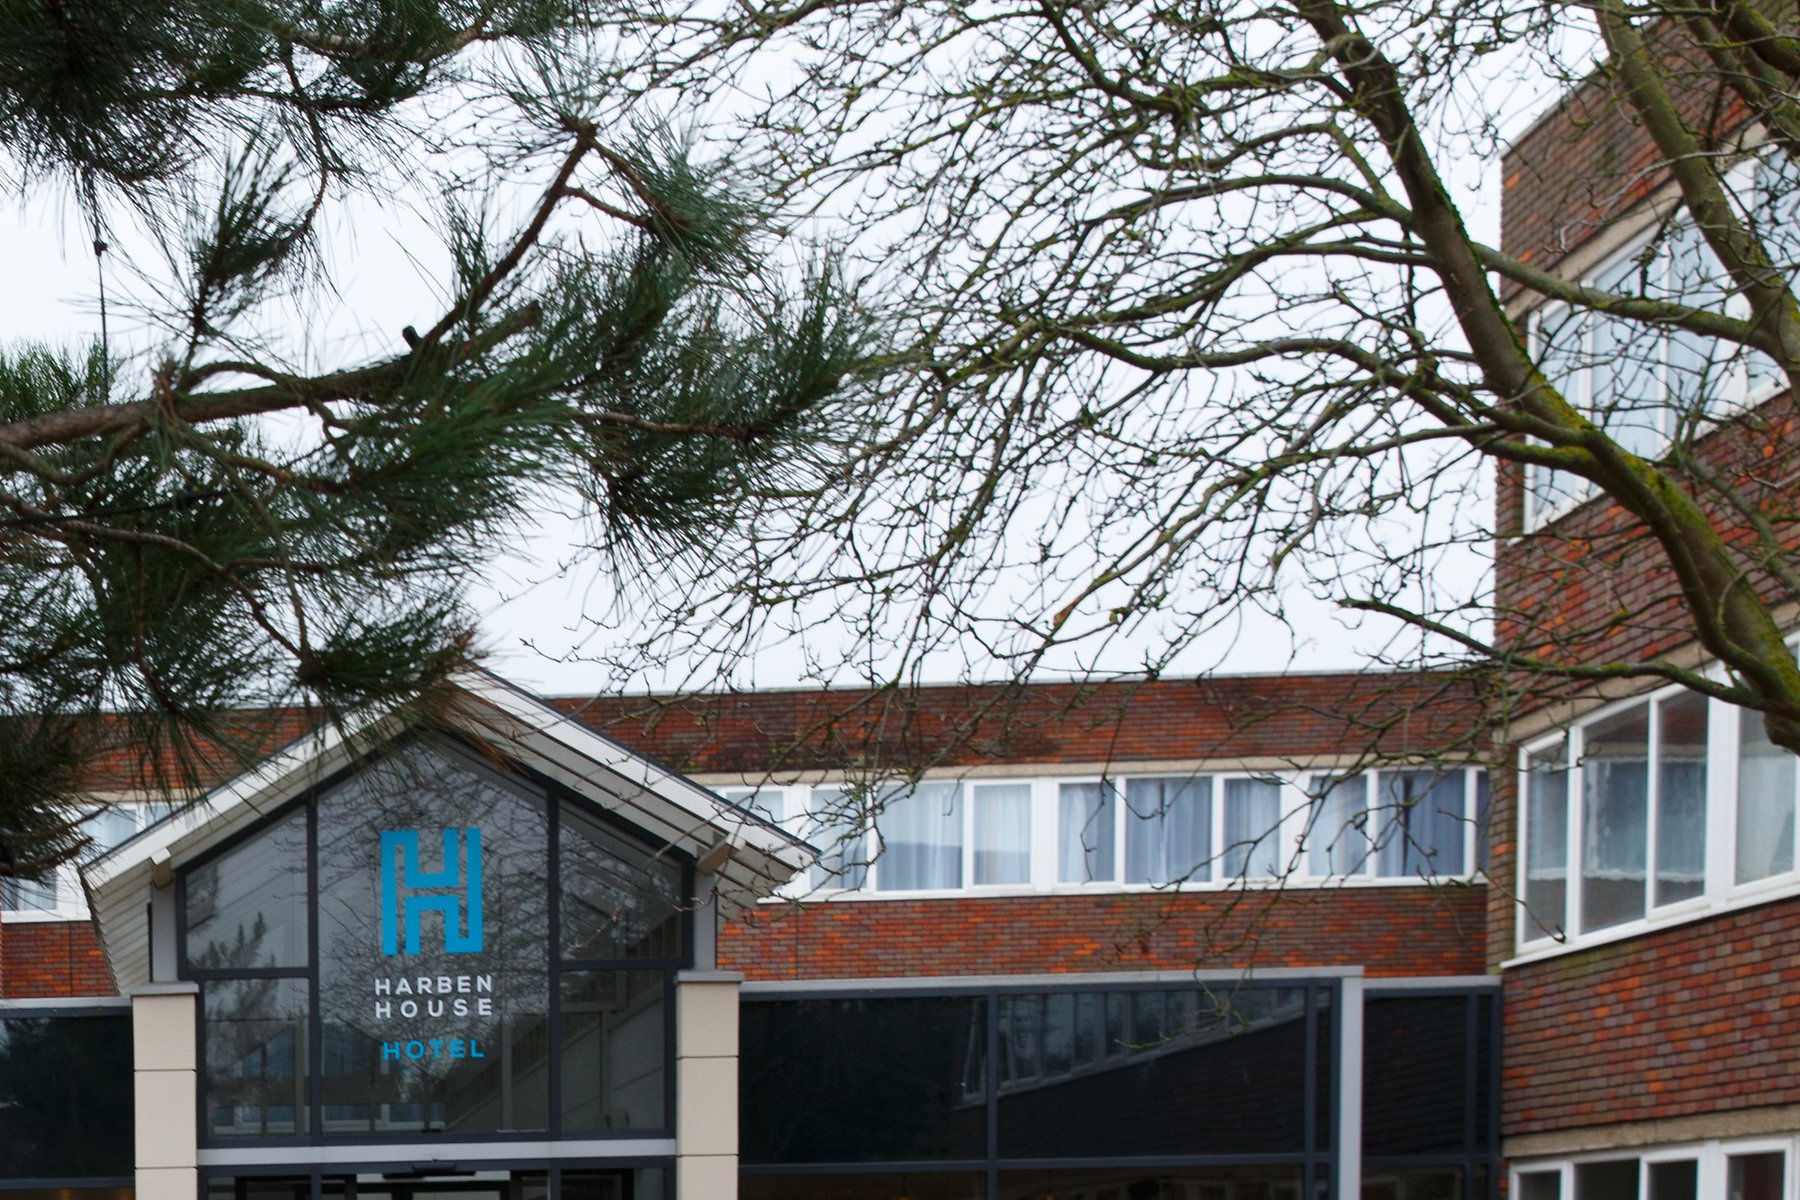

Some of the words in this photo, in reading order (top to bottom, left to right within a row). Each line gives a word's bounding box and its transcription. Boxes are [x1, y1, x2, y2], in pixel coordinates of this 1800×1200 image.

[375, 975, 492, 995] HARBEN
[375, 998, 492, 1018] HOUSE
[382, 1039, 485, 1061] HOTEL
